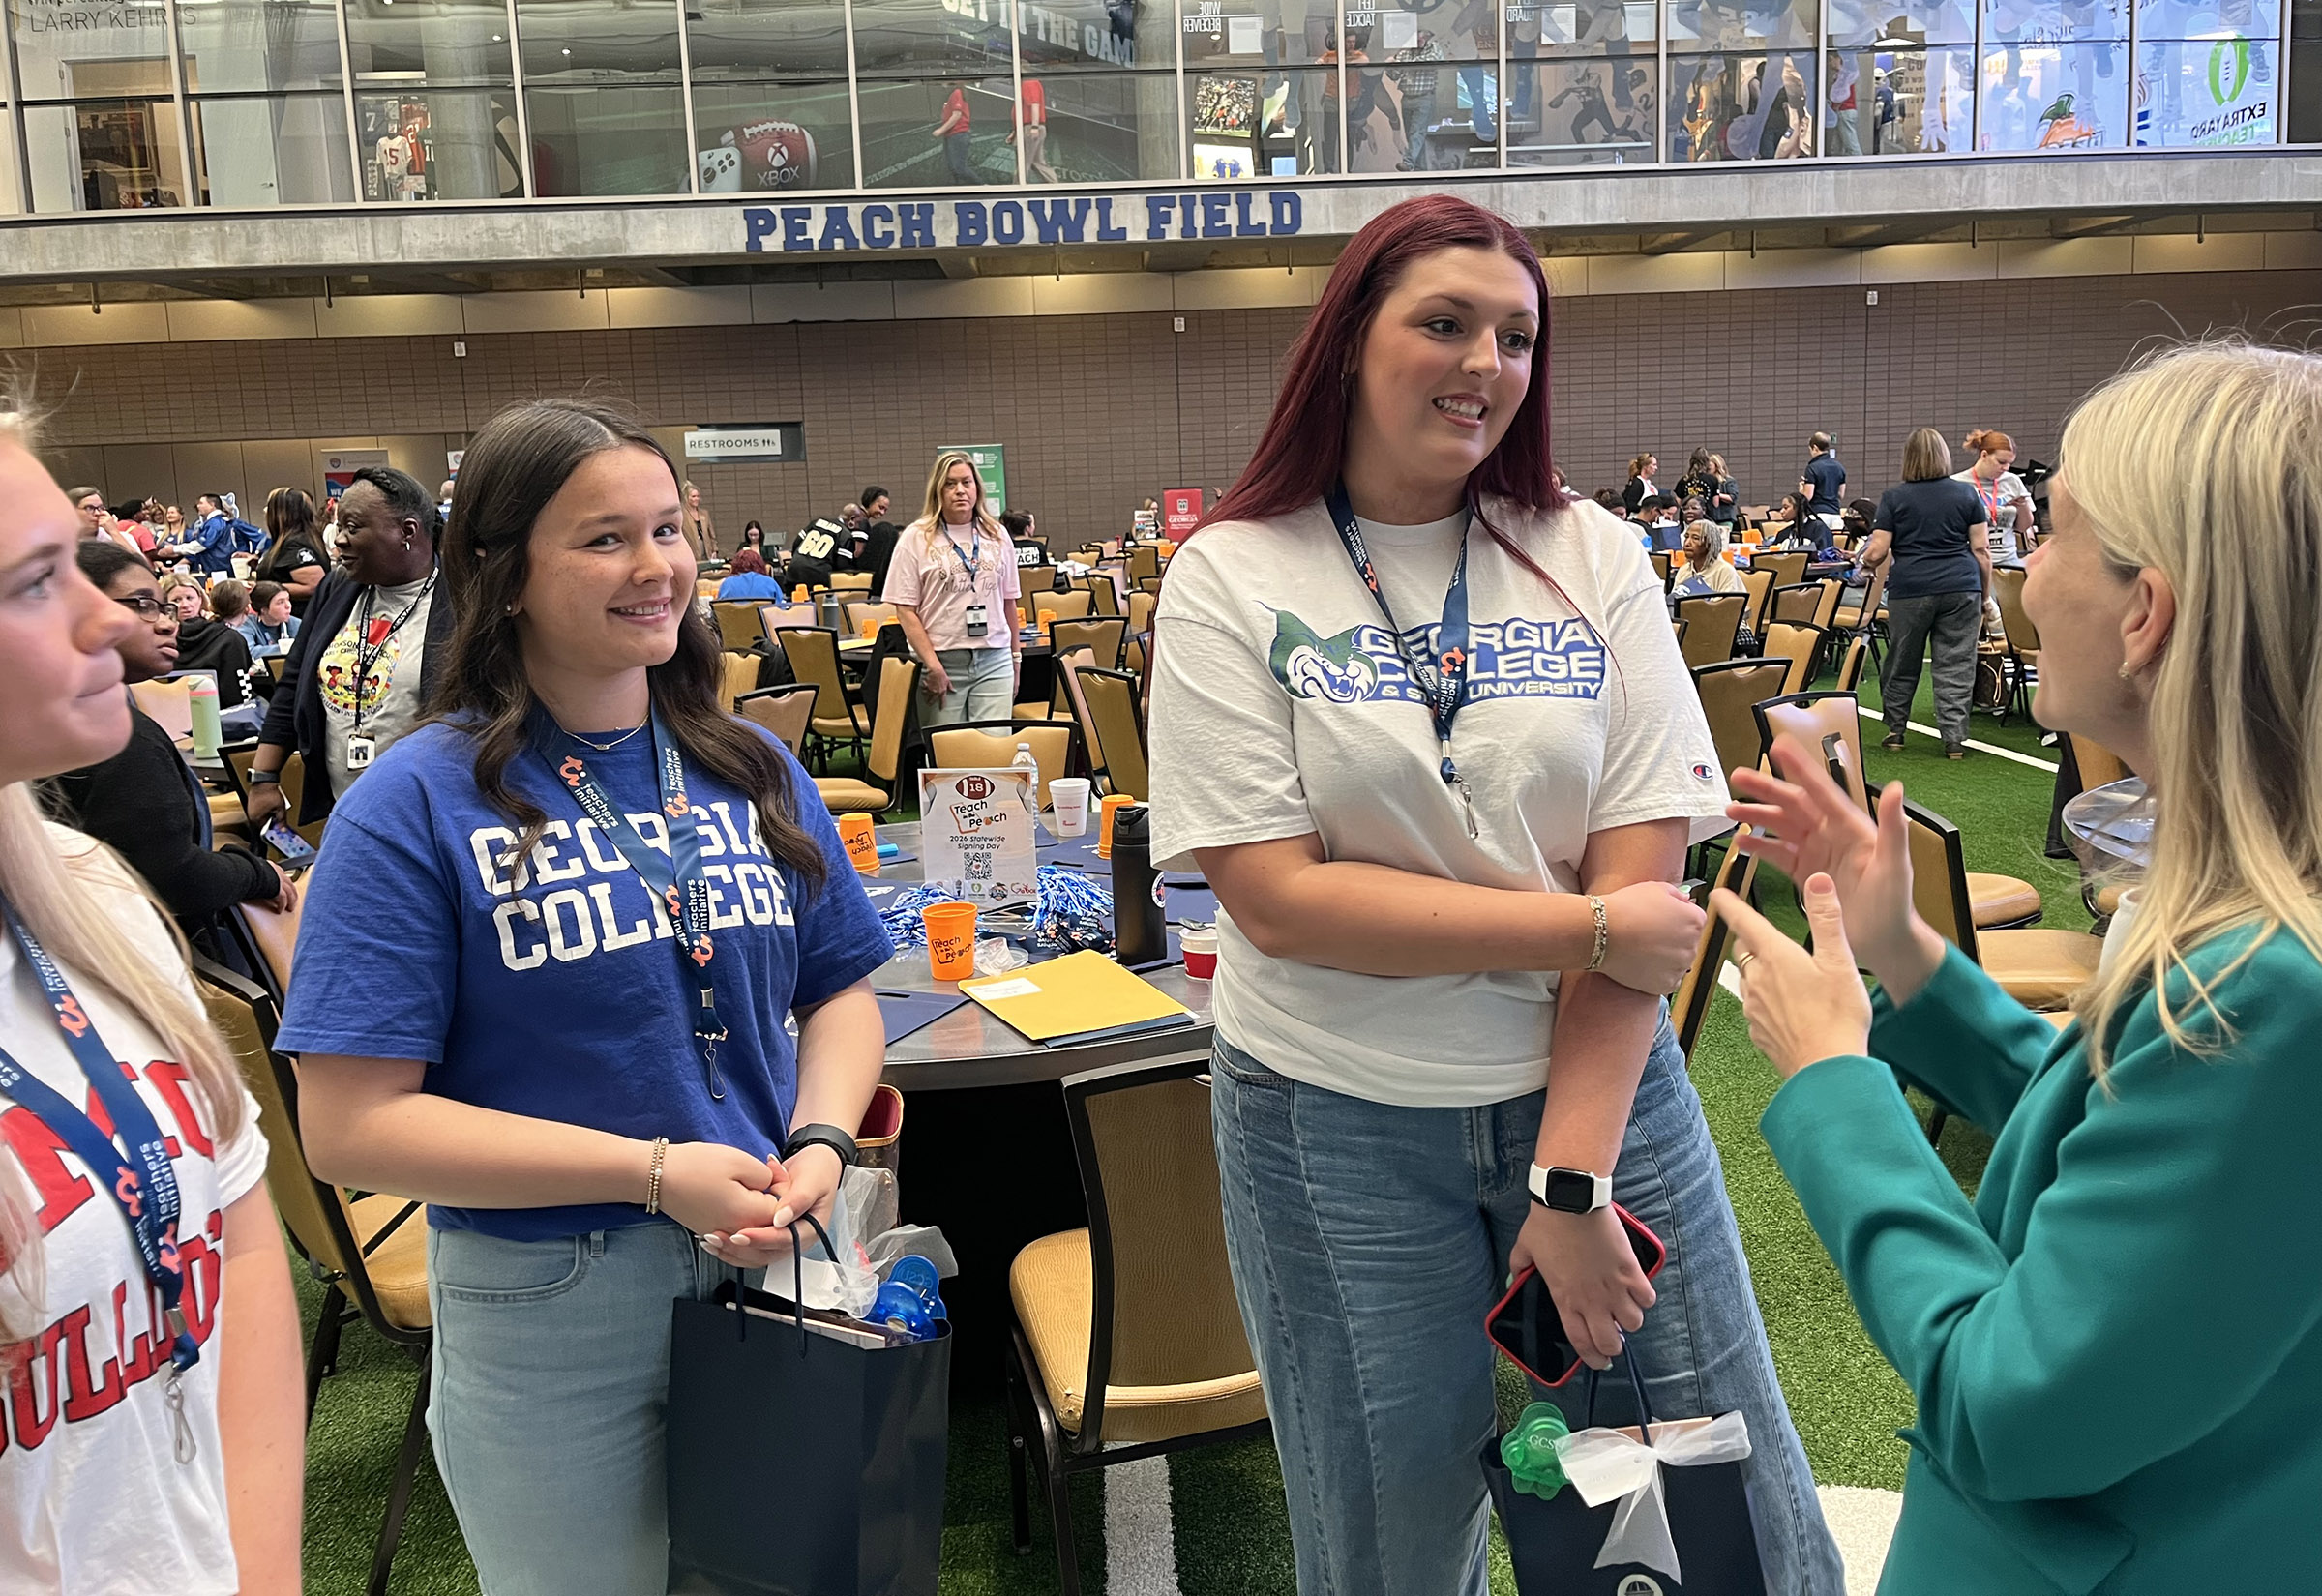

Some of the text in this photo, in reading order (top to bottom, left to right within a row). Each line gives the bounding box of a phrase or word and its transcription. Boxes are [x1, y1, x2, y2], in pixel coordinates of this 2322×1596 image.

[30, 7, 196, 33] LARRY KEHRS
[1031, 6, 1079, 51] THE
[384, 148, 399, 165] 15
[757, 165, 800, 187] XBOX
[743, 192, 1303, 251] PEACH BOWL FIELD
[690, 438, 759, 449] RESTROOMS
[798, 529, 835, 559] 60
[1018, 553, 1038, 563] ACH
[1468, 681, 1602, 701] UNIVERSITY
[665, 747, 678, 791] teachers
[672, 750, 685, 792] initiative
[968, 783, 984, 792] 18
[574, 785, 610, 830] initiative
[583, 783, 619, 828] teachers
[954, 800, 988, 815] Teach
[968, 813, 1007, 828] Pech
[687, 878, 700, 933] teachers
[696, 878, 708, 932] initiative
[934, 936, 961, 948] Teach
[139, 1142, 169, 1223] teachers
[152, 1140, 180, 1220] initiative
